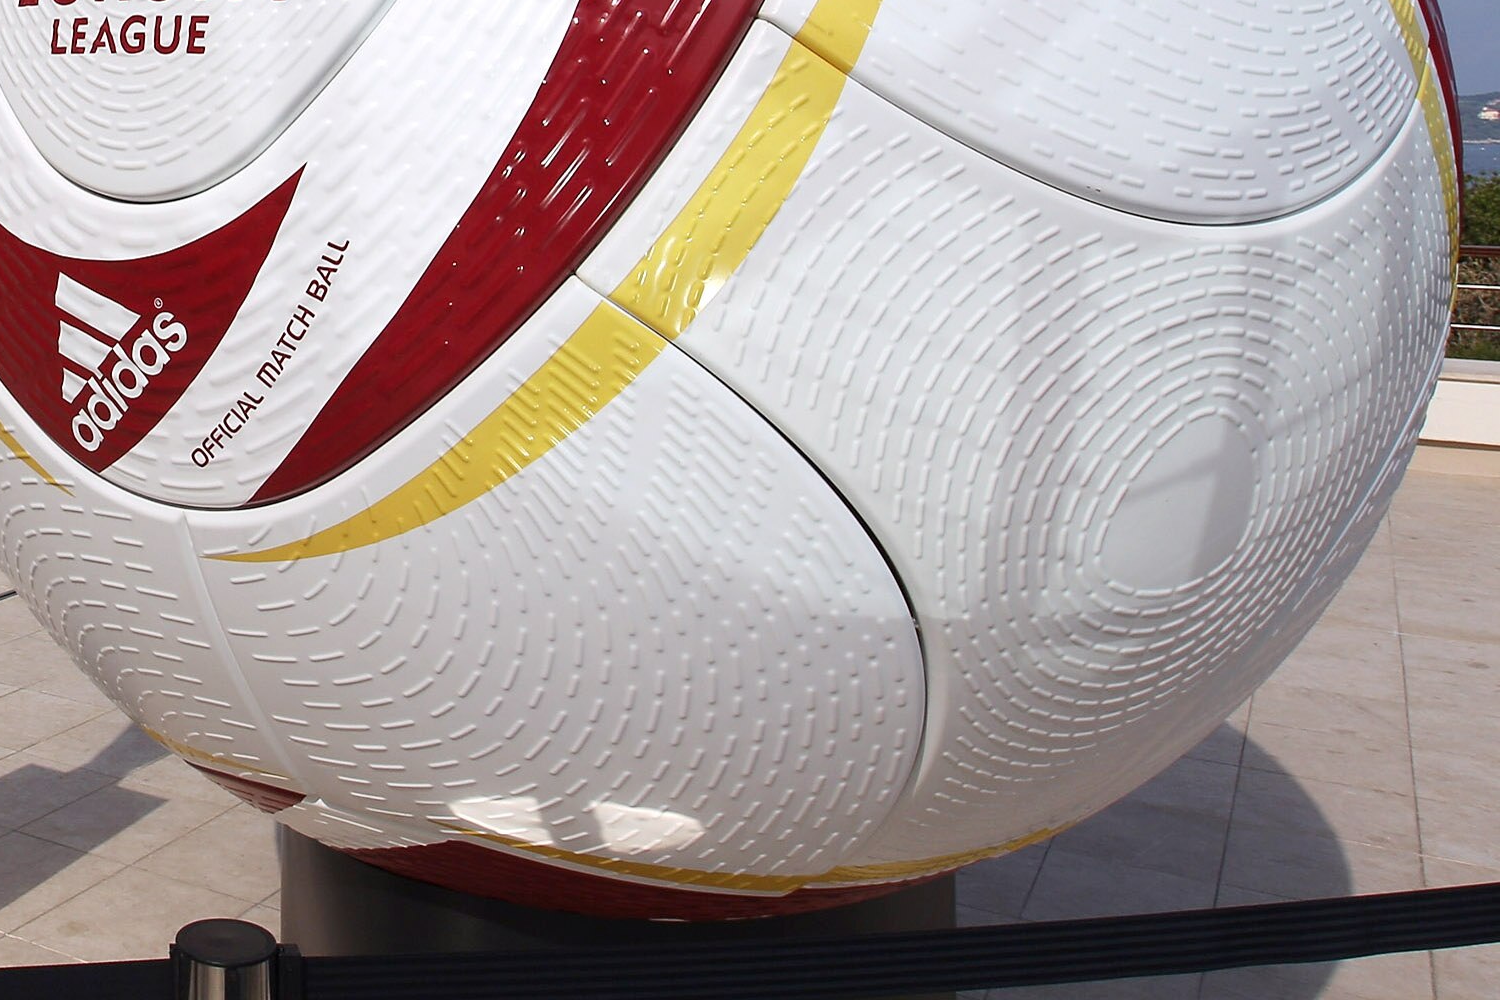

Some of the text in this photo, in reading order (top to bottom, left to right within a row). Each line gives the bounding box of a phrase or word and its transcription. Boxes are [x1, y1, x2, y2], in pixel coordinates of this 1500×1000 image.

[51, 15, 209, 55] LEAGUE
[71, 311, 187, 452] adidas
[191, 240, 350, 468] OFFICIAL MATCH BALL
